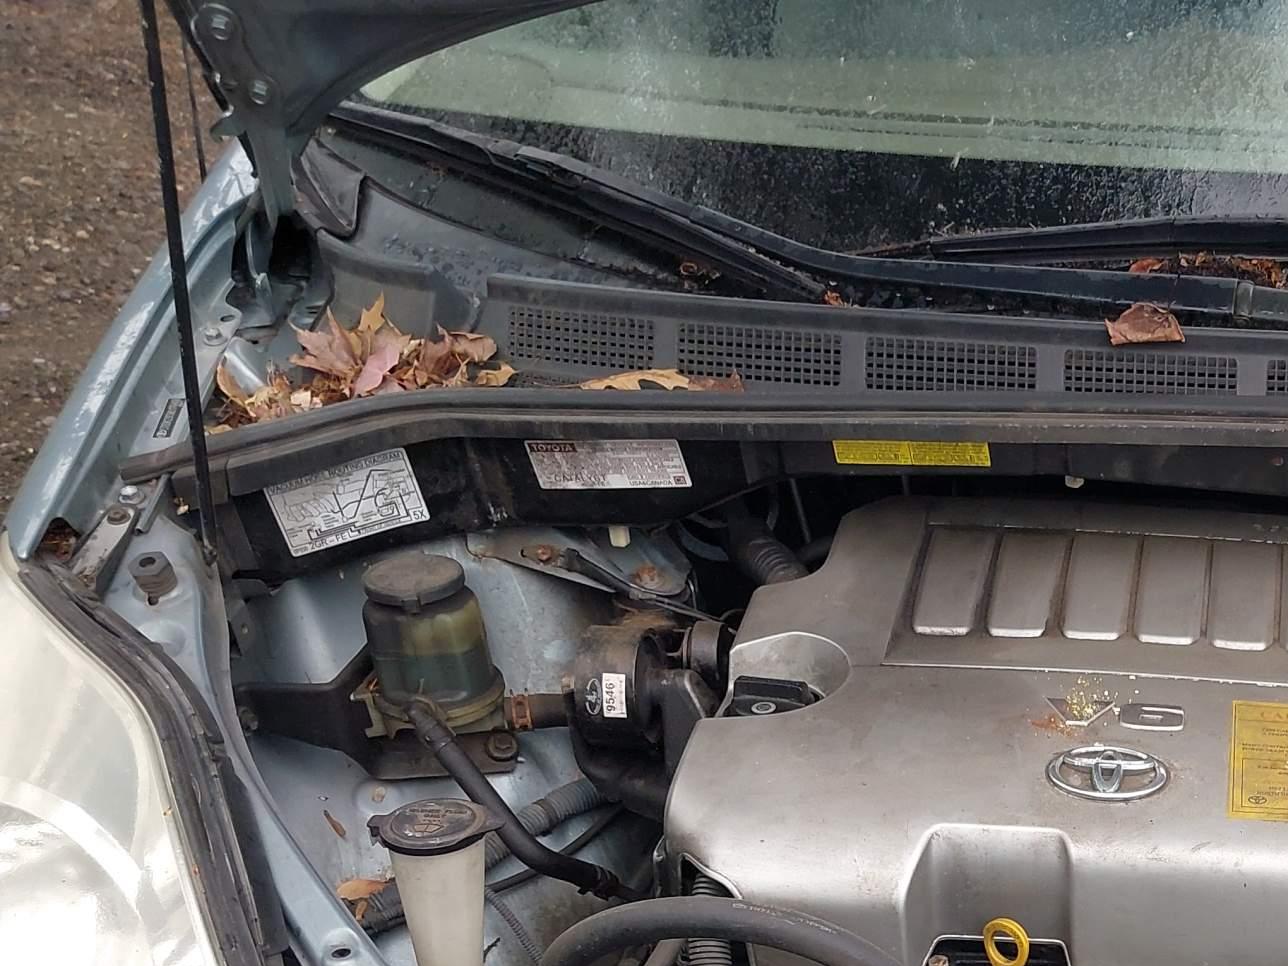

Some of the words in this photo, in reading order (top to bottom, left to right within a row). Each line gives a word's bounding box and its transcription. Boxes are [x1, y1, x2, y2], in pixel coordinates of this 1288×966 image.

[531, 443, 573, 452] TOYOTA
[412, 509, 427, 520] 5X
[605, 682, 616, 712] 9546
